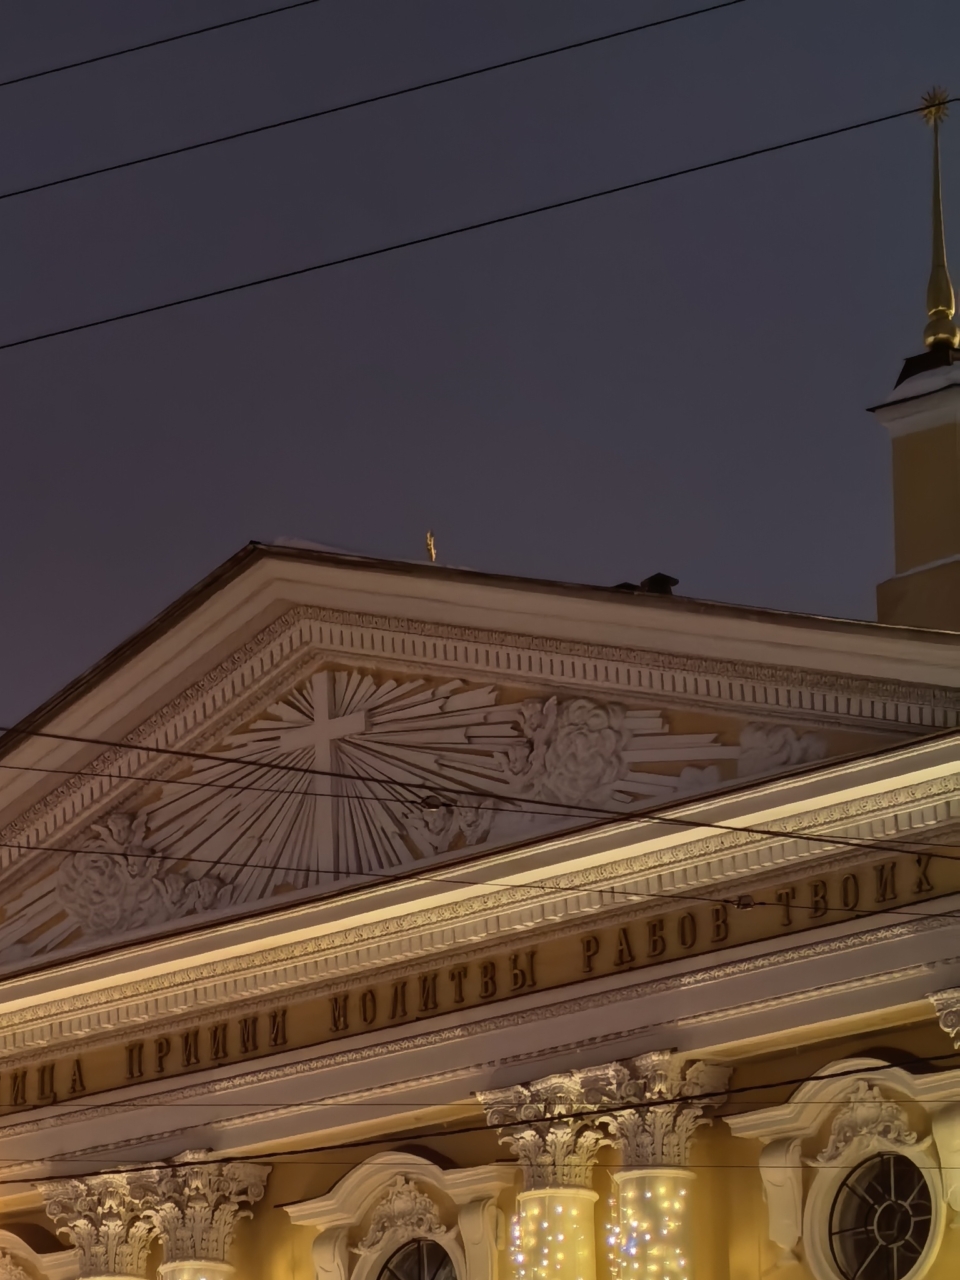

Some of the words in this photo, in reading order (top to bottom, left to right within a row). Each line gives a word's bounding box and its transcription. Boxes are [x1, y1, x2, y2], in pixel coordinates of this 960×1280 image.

[125, 1009, 288, 1079] ПРИИМИ
[329, 951, 538, 1032] МОЛИТВЫ
[581, 904, 729, 973] РАБОВ
[776, 854, 934, 926] ТВОИХ
